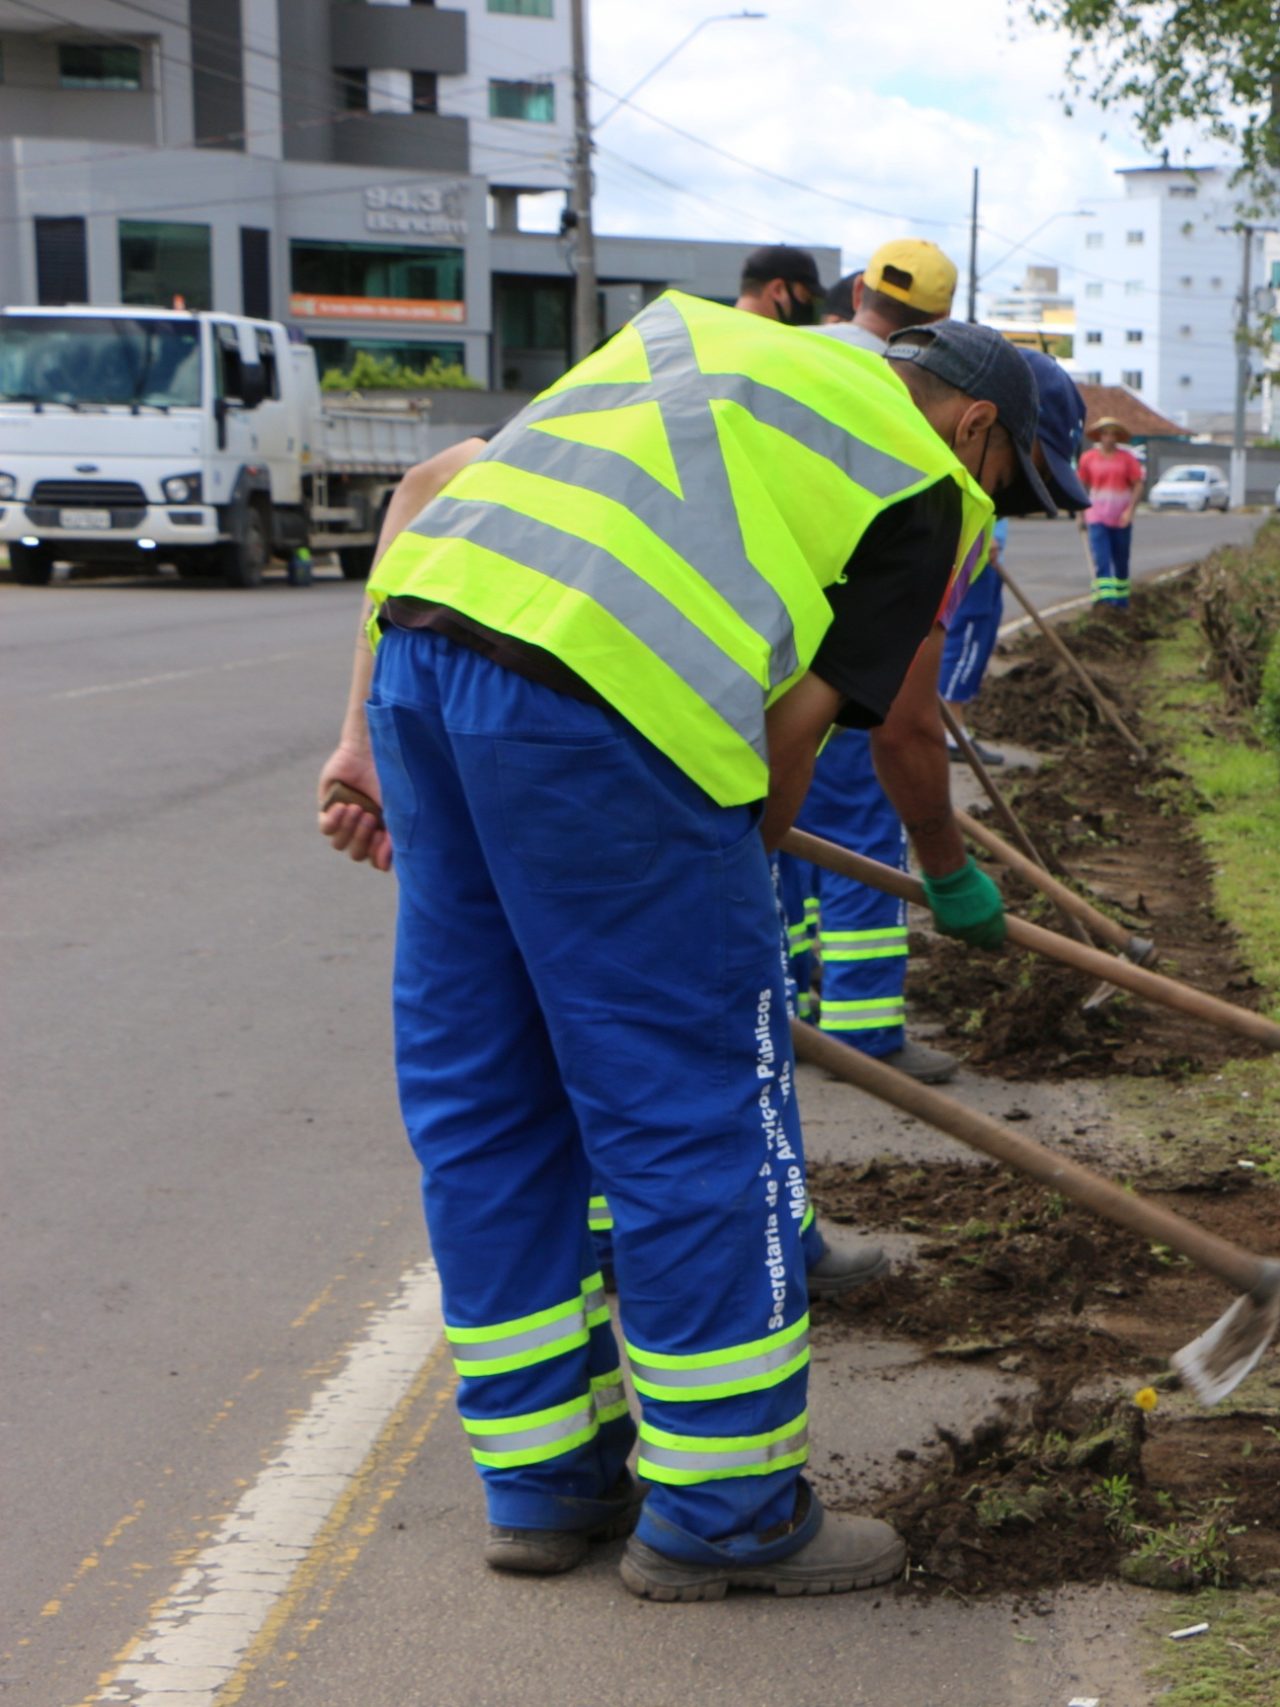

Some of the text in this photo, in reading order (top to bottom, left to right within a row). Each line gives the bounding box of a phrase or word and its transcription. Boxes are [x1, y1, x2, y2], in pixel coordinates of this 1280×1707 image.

[755, 988, 775, 1079] Públicos
[765, 1180, 778, 1207] de
[785, 1165, 806, 1219] Meio
[764, 1213, 786, 1330] Secretaria
